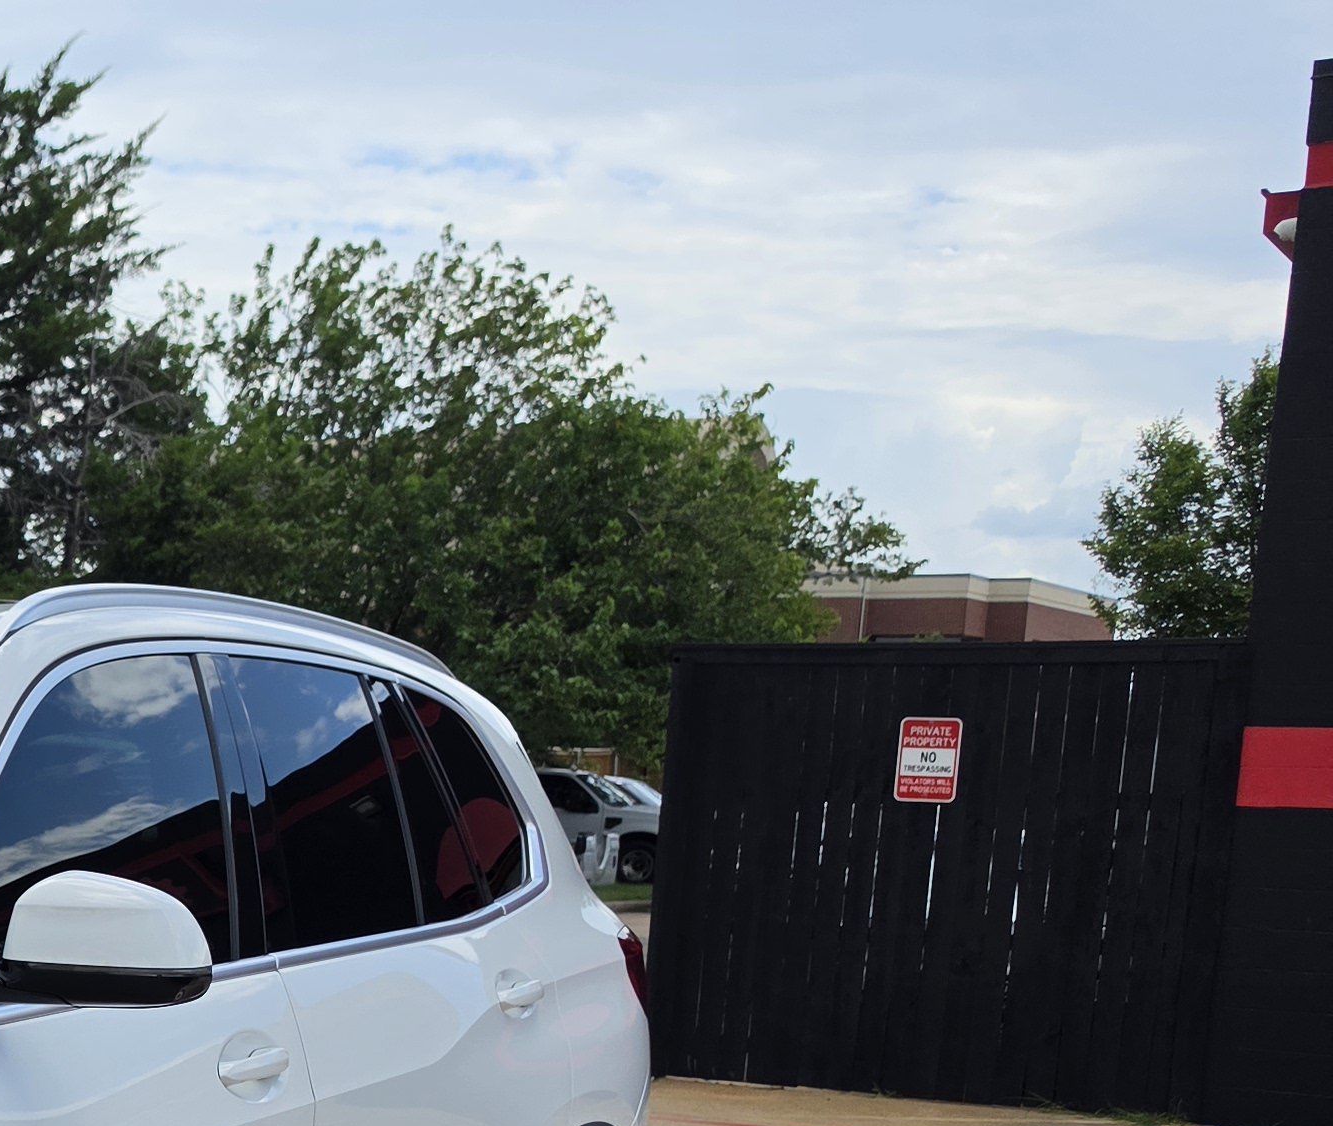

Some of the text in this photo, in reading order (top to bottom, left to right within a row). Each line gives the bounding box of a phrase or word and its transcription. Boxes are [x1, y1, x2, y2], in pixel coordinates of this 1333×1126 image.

[910, 726, 952, 737] PRIVATE
[903, 736, 957, 747] PROPERTY
[920, 751, 937, 763] NO
[904, 764, 951, 774] TRESPASSING
